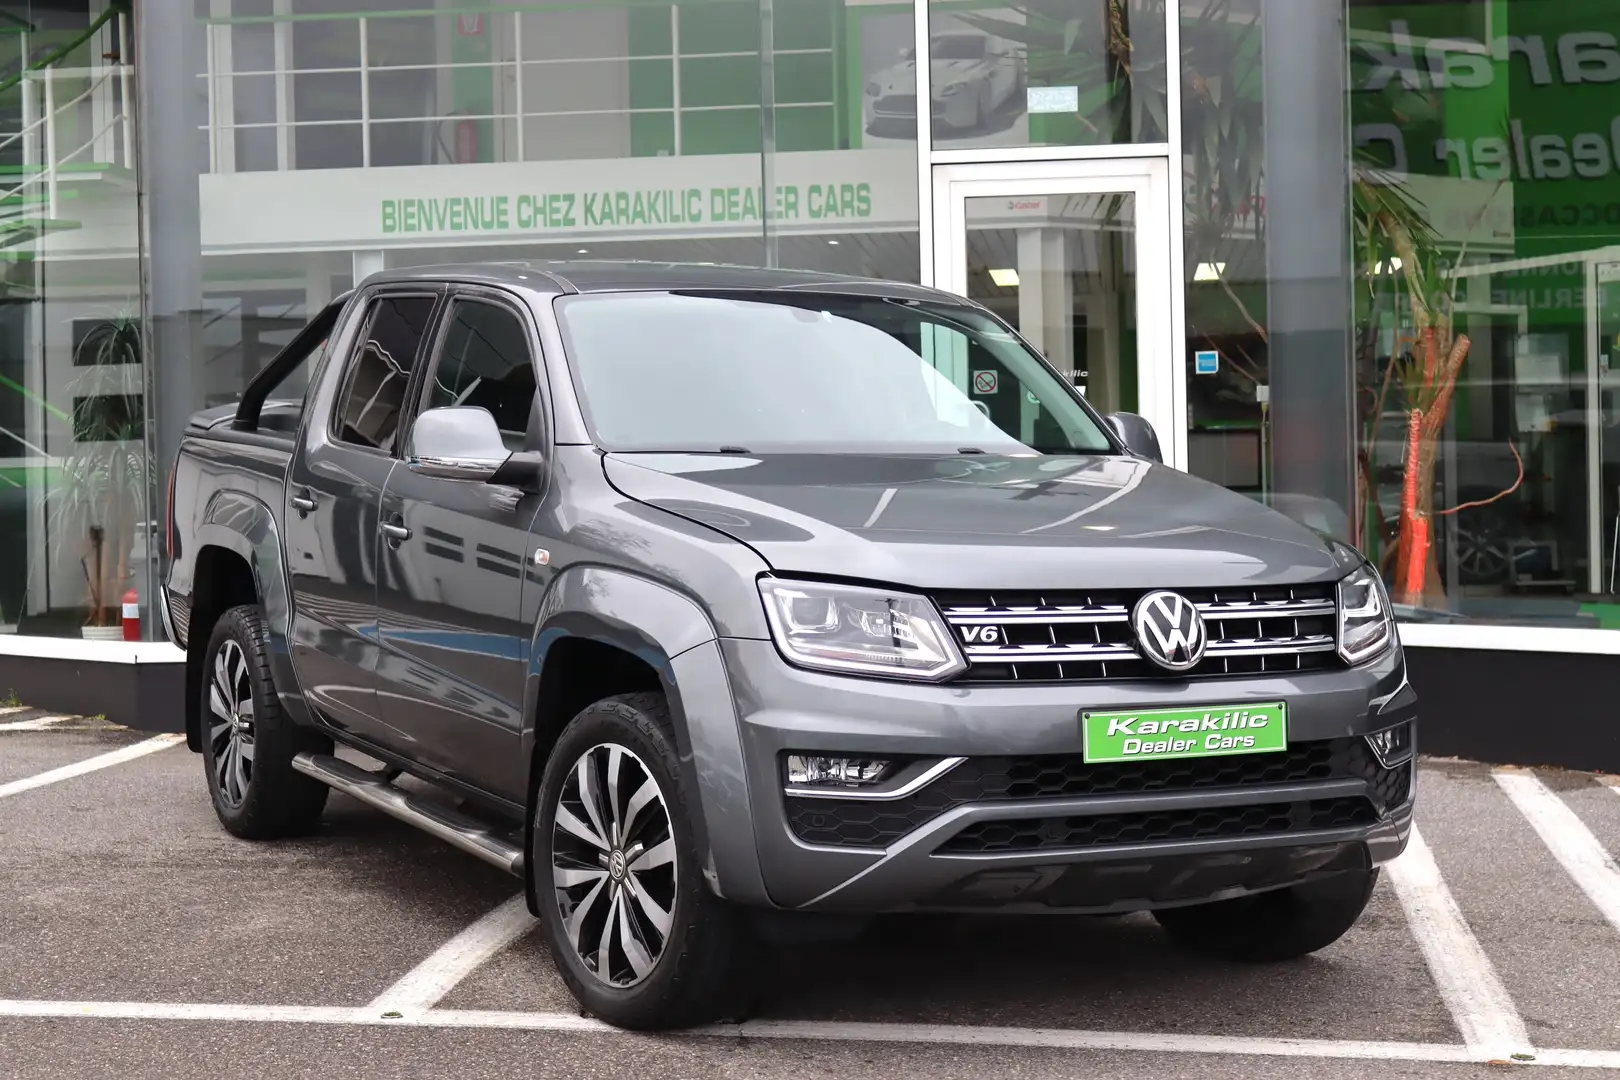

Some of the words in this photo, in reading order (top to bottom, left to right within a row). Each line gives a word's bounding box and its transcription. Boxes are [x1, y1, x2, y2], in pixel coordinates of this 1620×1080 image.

[382, 196, 509, 233] BIENVENUE
[517, 193, 575, 228] CHEZ
[584, 188, 702, 226] KARAKILIC
[808, 182, 871, 218] CARS
[960, 626, 998, 642] V6
[1107, 712, 1269, 736] Karakilic
[1123, 737, 1197, 755] Dealer
[1204, 734, 1255, 750] Cars
